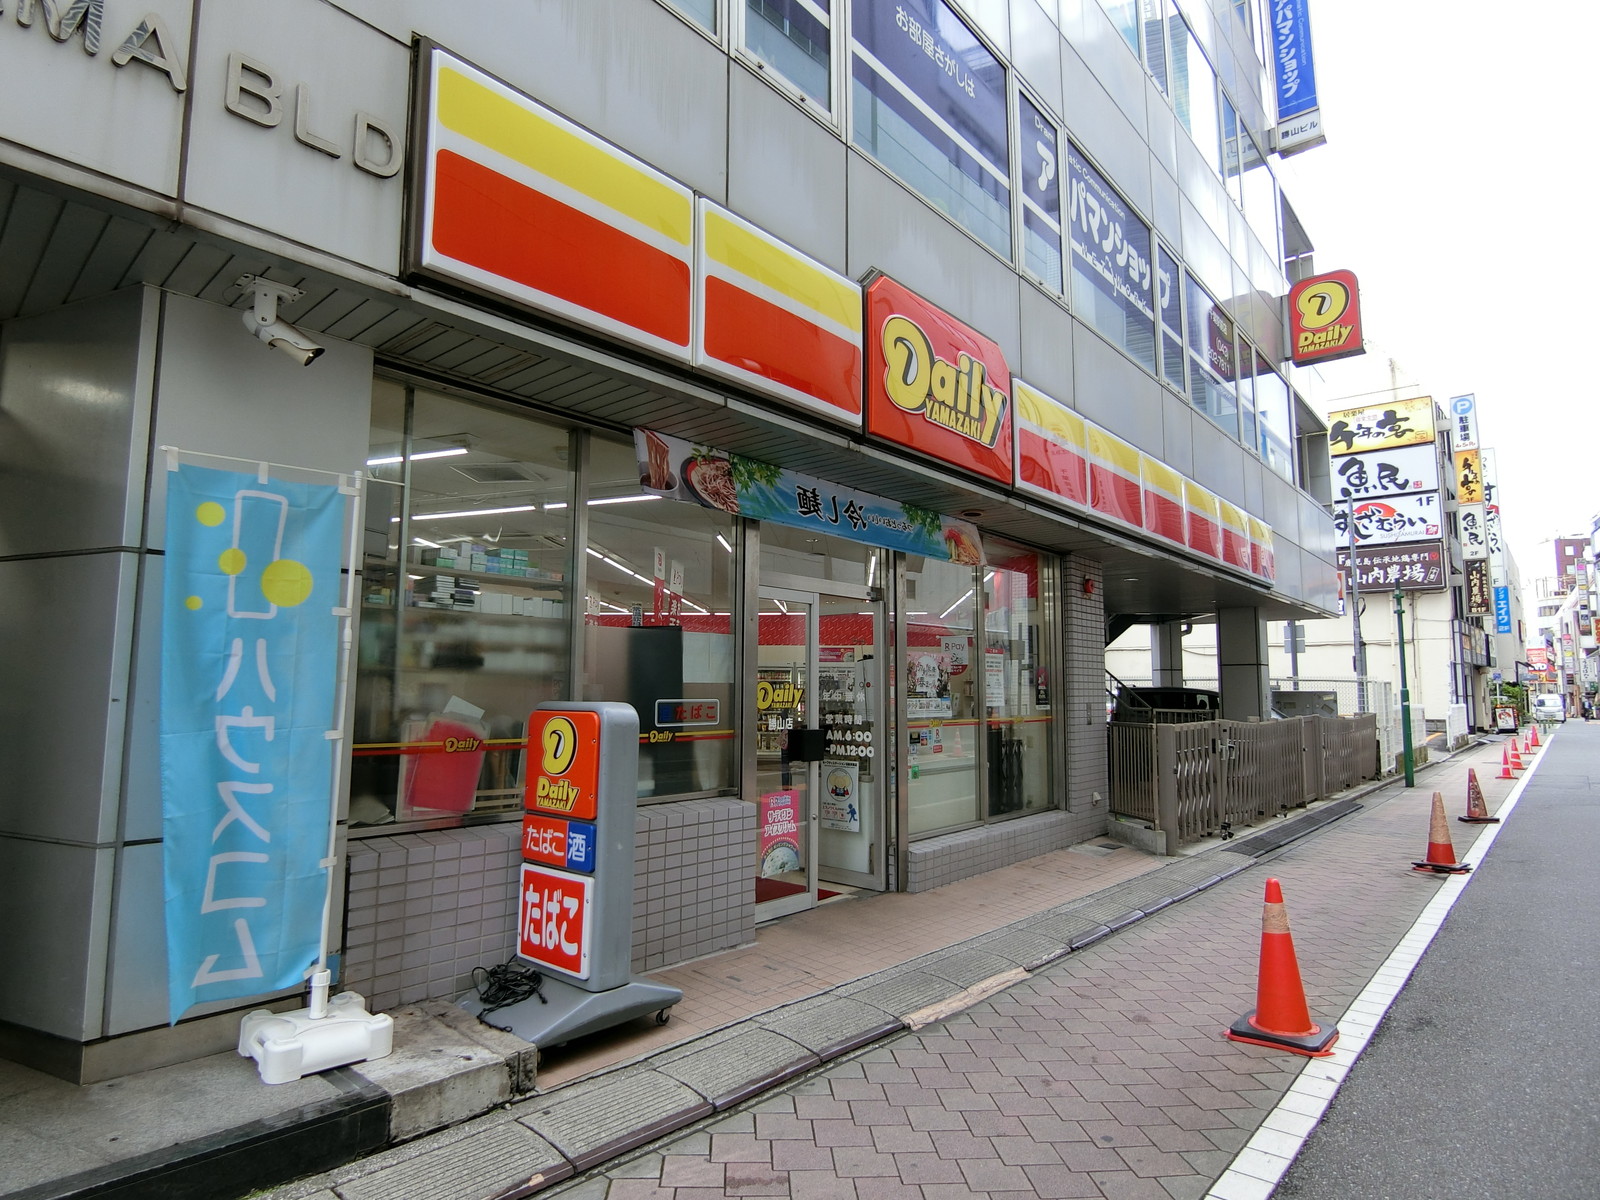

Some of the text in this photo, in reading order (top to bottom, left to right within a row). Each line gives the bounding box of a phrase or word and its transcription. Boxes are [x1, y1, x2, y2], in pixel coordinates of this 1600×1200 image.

[895, 5, 976, 99] お部屋さがしは
[223, 51, 403, 179] BLD
[1082, 166, 1127, 222] Communication
[1298, 324, 1355, 347] Daily
[1298, 338, 1341, 354] YAMAZAKI
[883, 316, 1007, 447] Daily
[925, 396, 982, 441] YAMAZAKI
[1329, 409, 1415, 451] 千年の宴
[1459, 416, 1471, 442] 駐車場
[1337, 456, 1410, 498] 魚民
[1416, 496, 1435, 507] 1F
[1462, 512, 1484, 546] 魚民
[1348, 563, 1426, 586] 山内農場
[1496, 600, 1509, 623] エイワ
[951, 642, 965, 651] Pay
[757, 682, 804, 710] Daily
[675, 703, 716, 720] たばこ
[768, 715, 794, 731] 勝山店
[825, 714, 863, 726] 営業時間
[444, 737, 480, 753] Daily
[649, 730, 673, 743] Daily
[825, 729, 873, 743] AM.6:00
[537, 776, 579, 811] Daily
[538, 796, 568, 810] YAMAZAKI
[764, 820, 797, 837] アイスクリーム
[526, 824, 587, 863] たばこ 酒
[524, 883, 580, 956] たばこ
